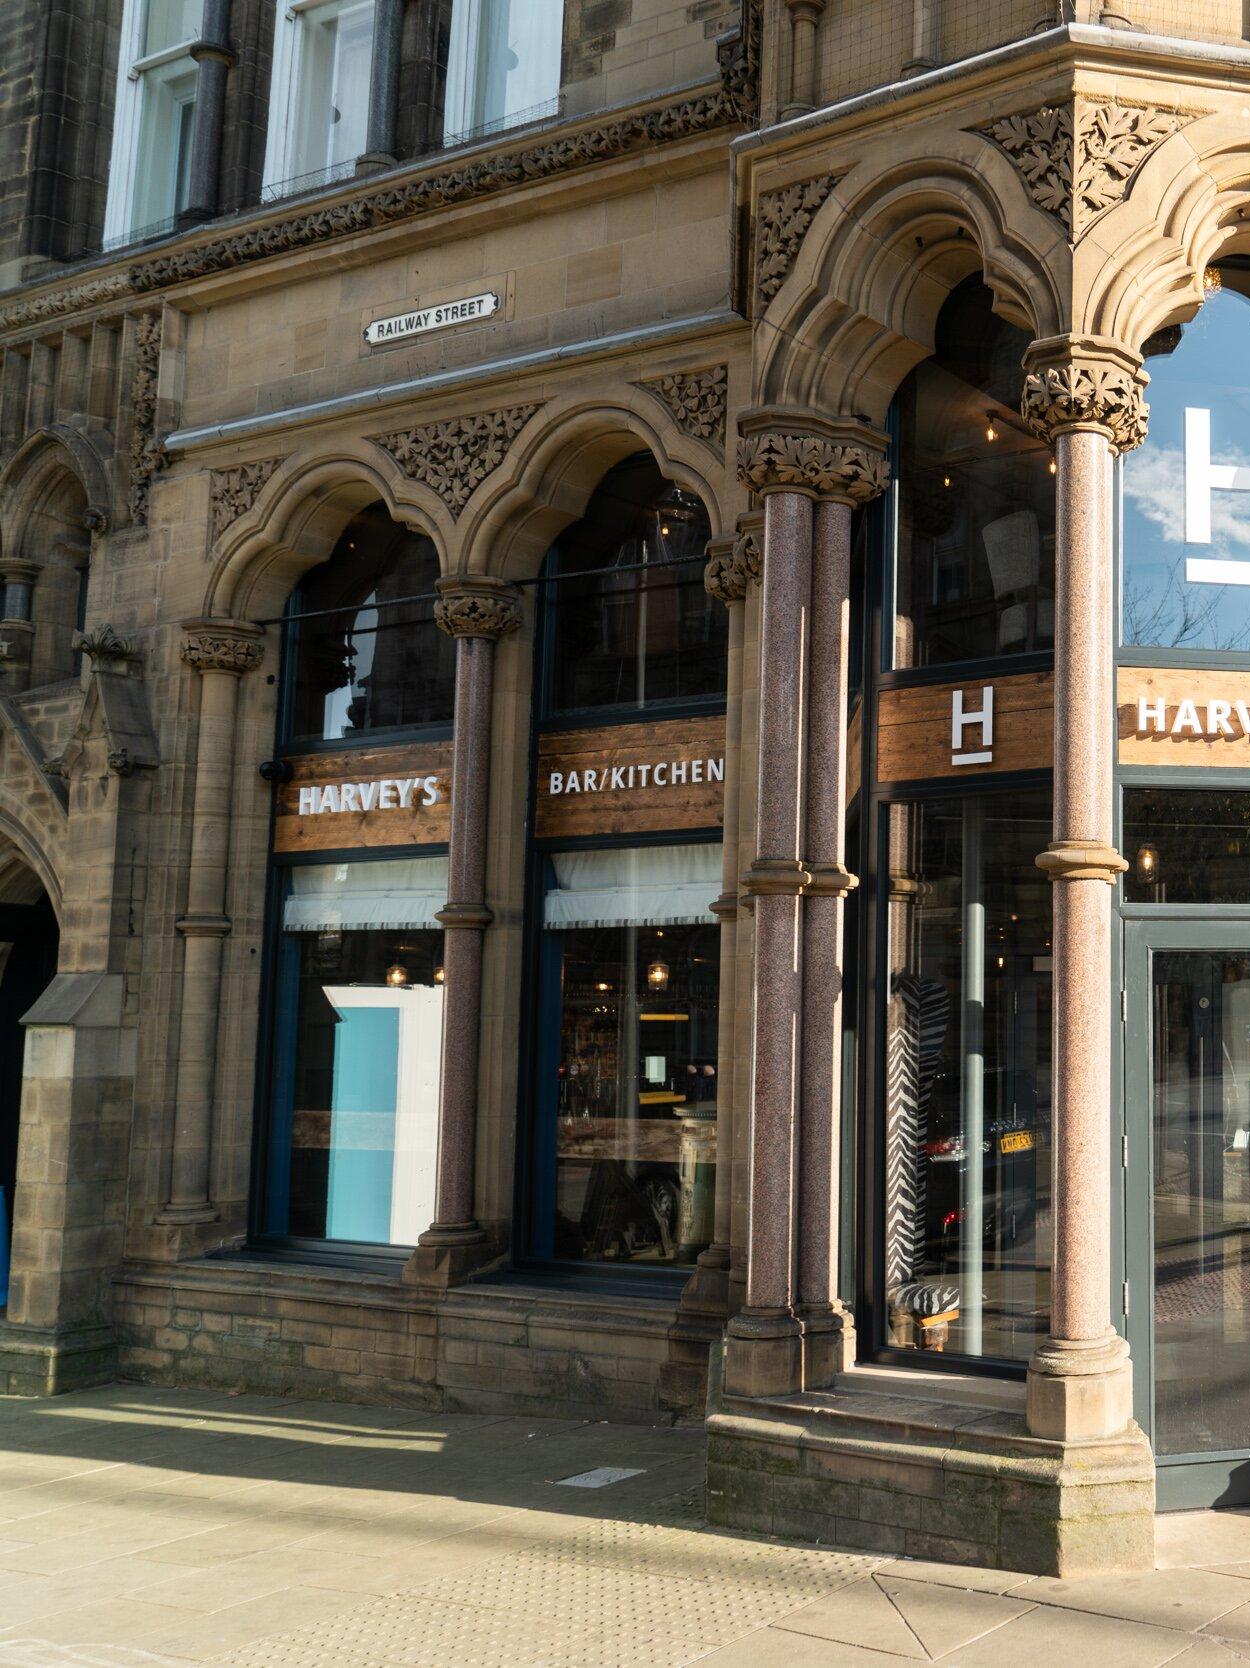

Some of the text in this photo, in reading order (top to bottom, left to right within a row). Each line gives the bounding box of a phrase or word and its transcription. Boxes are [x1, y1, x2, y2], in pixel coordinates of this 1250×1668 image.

[377, 299, 484, 338] RAILWAY STREET
[951, 686, 993, 750] H
[298, 776, 440, 815] HARVEY'S
[549, 758, 724, 795] BAR/KITCHEN
